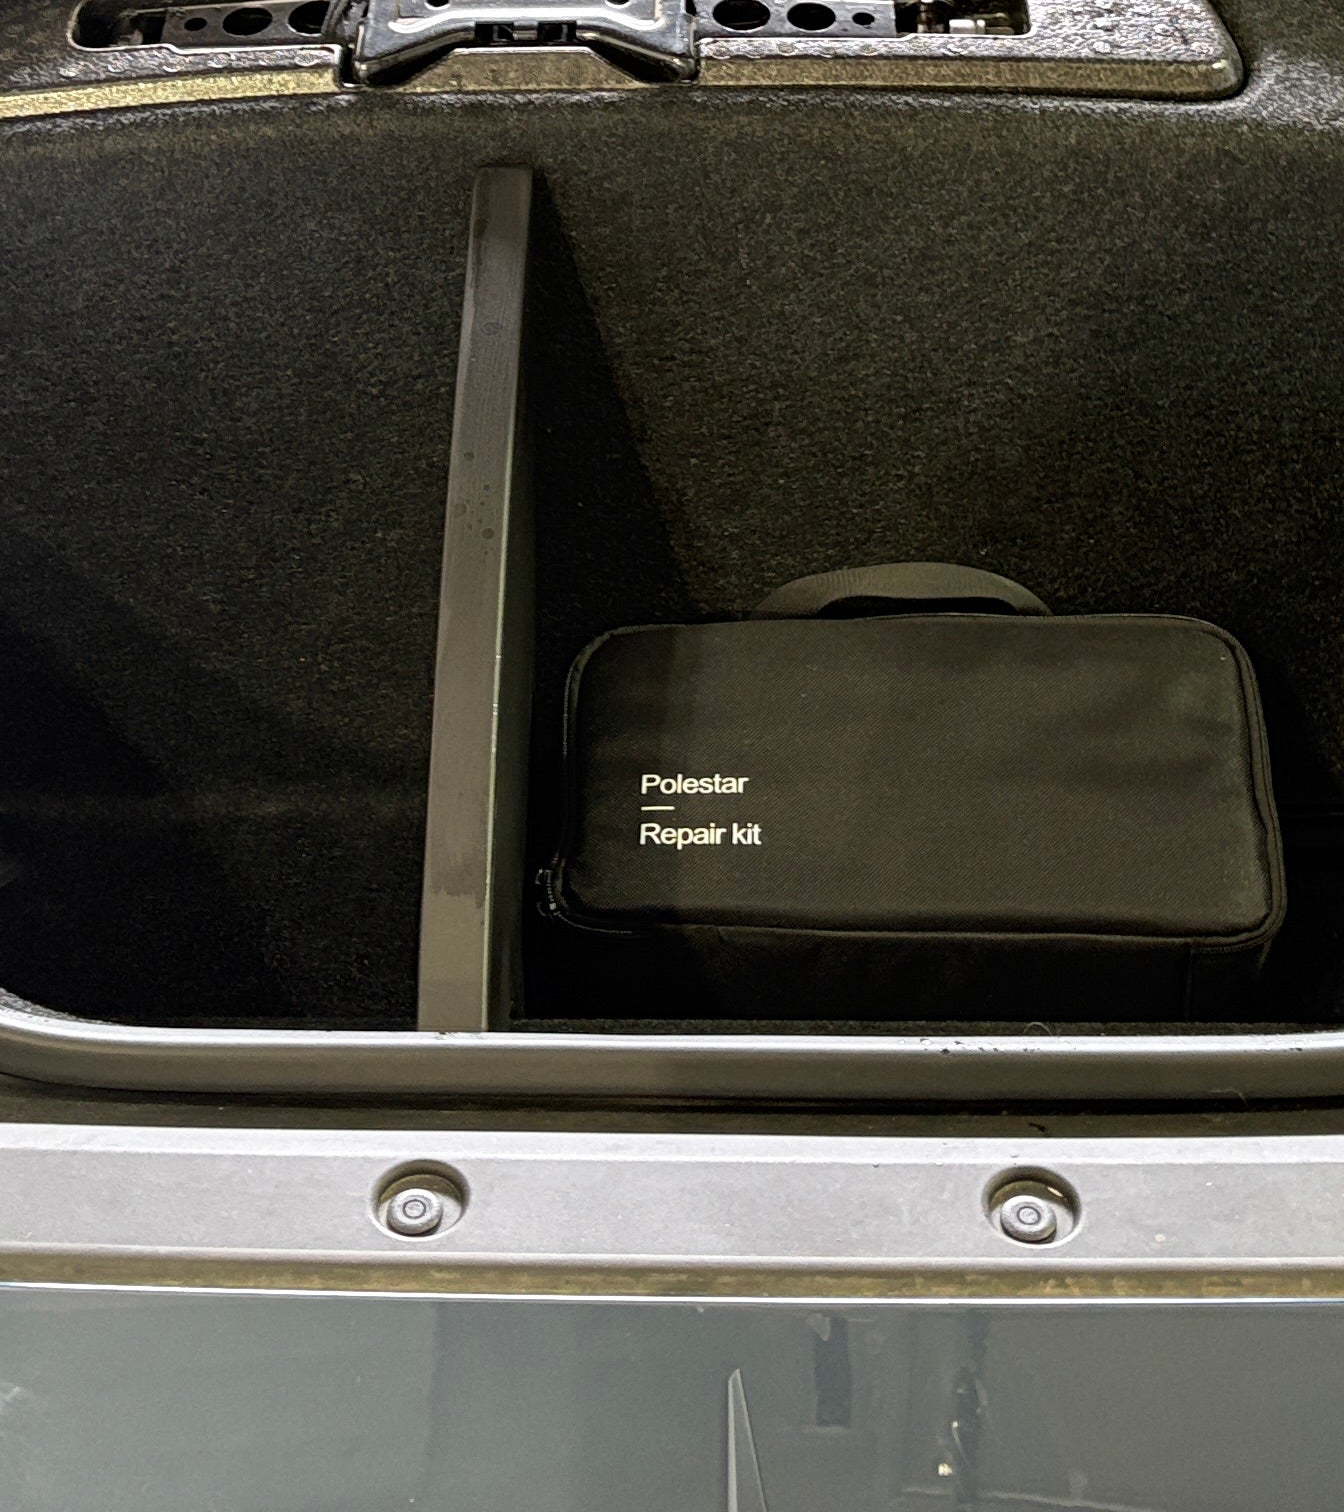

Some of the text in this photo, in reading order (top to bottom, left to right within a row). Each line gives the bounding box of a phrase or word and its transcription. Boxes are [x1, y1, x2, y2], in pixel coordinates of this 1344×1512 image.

[641, 773, 750, 795] Polestar
[639, 822, 763, 850] Repair kit
